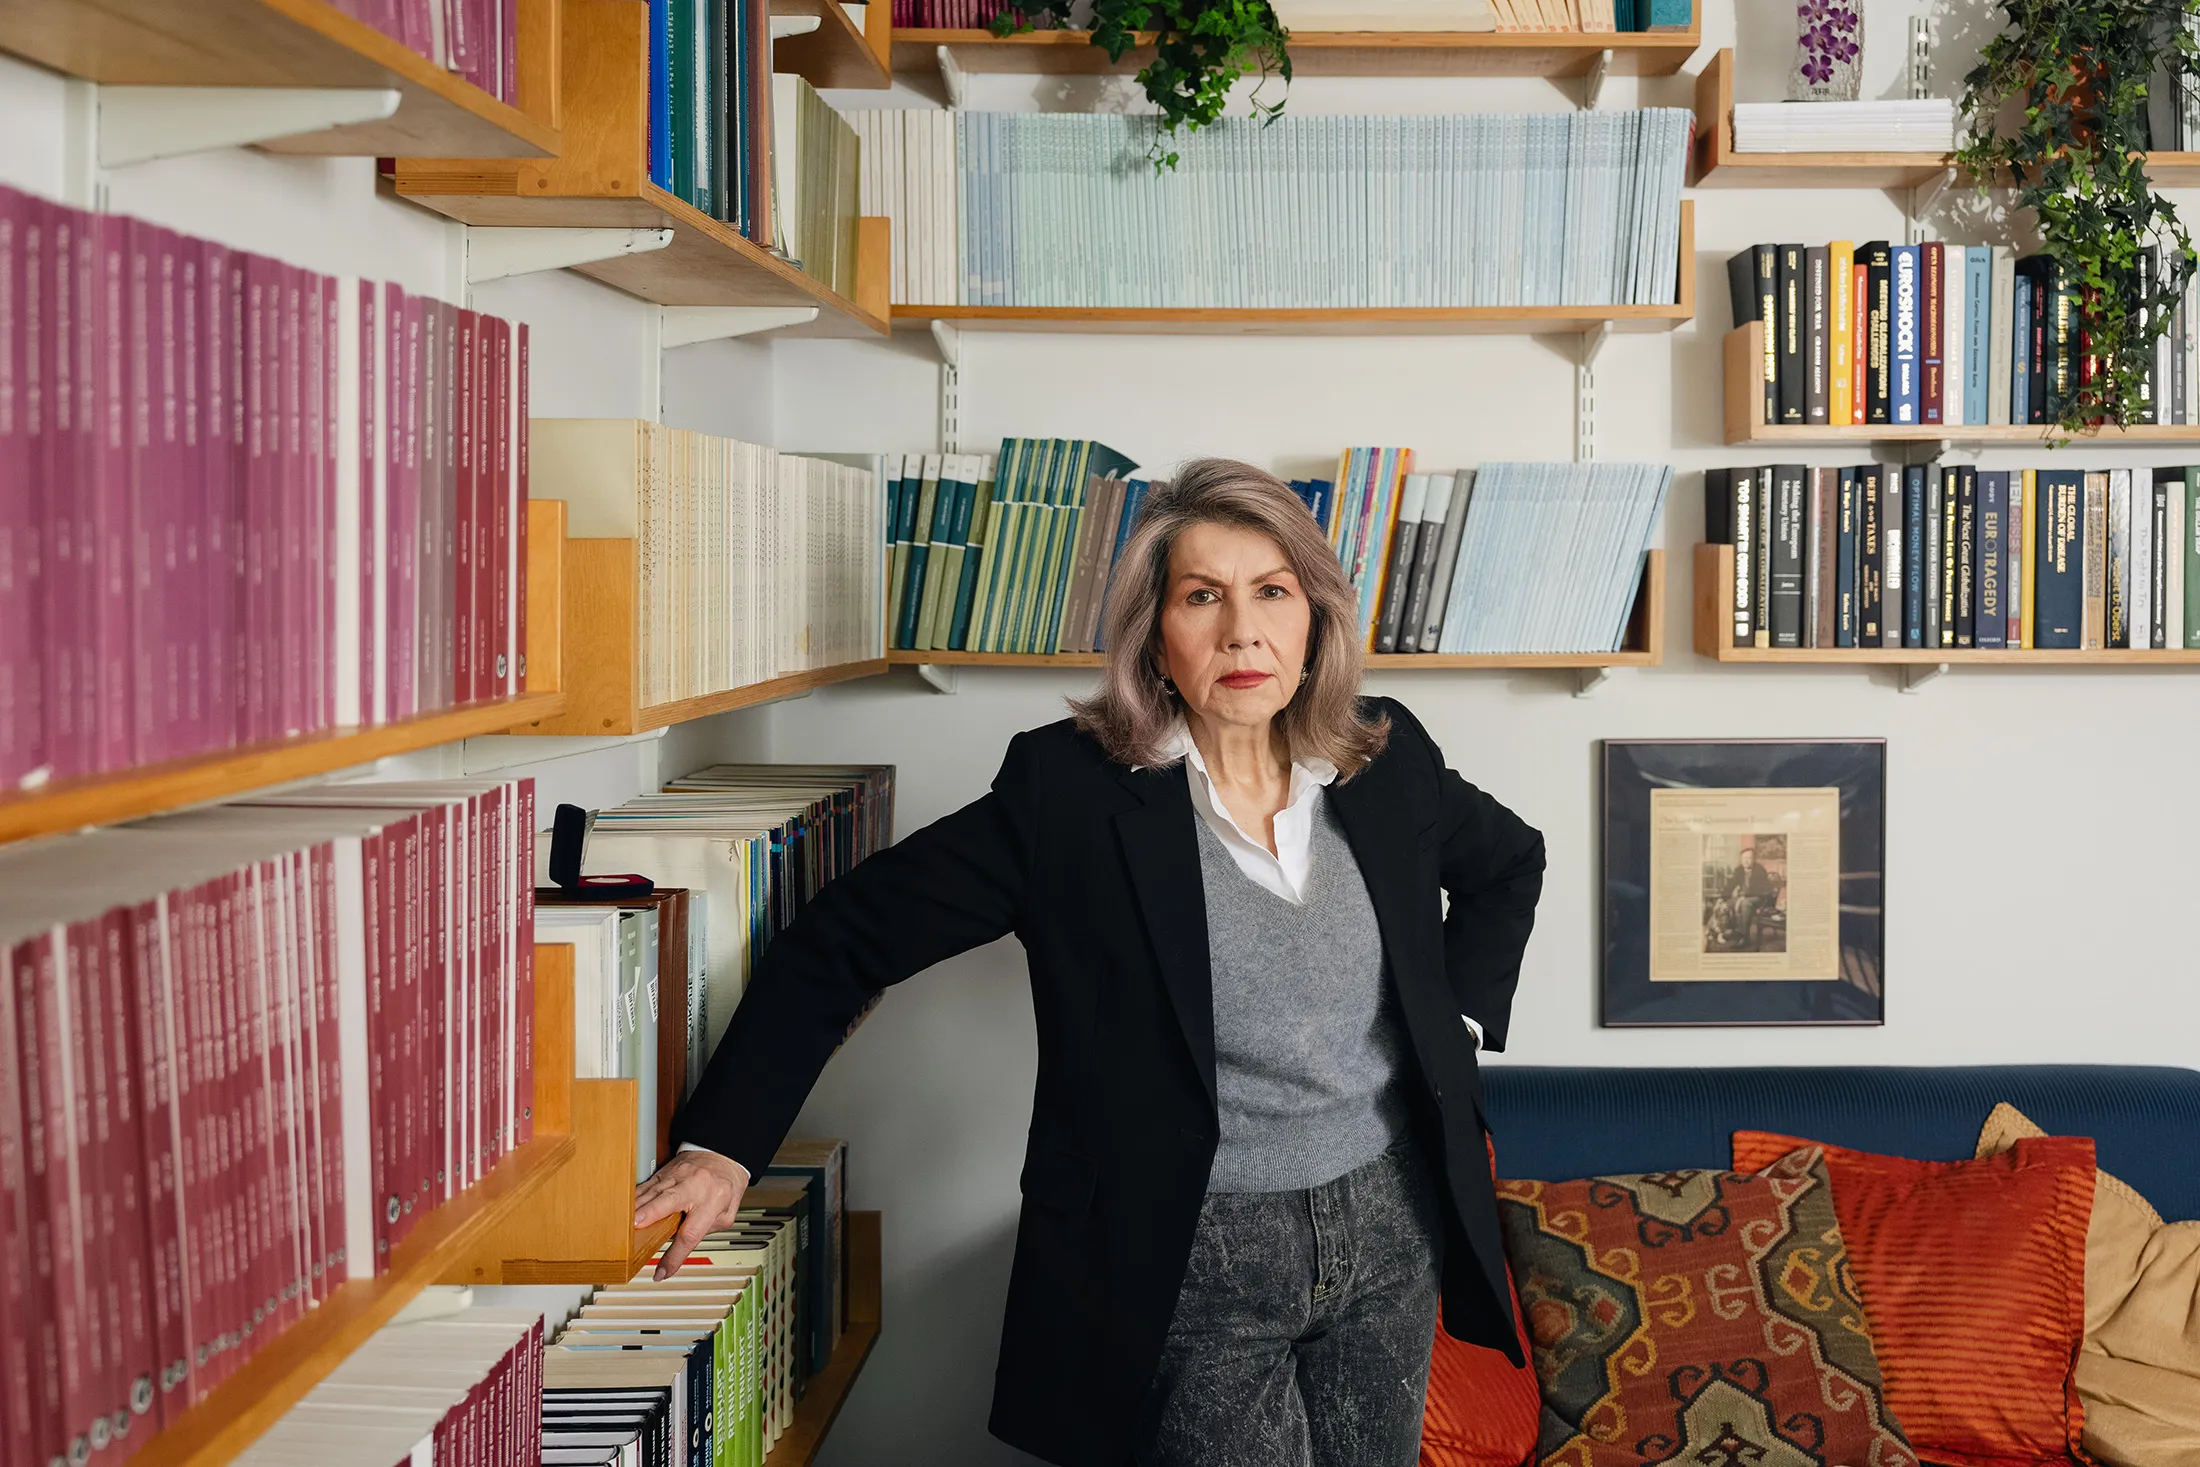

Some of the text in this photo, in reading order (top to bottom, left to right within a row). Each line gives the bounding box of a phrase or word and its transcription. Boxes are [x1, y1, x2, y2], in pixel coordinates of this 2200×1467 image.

[1780, 480, 1789, 541] Monetary Union
[1791, 480, 1800, 509] Making
[1912, 479, 1920, 522] OPTIMAL
[2009, 477, 2022, 554] TEN CRISES
[2067, 484, 2076, 542] THE GLOBAL
[1789, 524, 1799, 559] European
[1912, 526, 1920, 562] MONEY
[2057, 484, 2066, 573] BURDEN OF DISEASE
[1912, 564, 1920, 593] FLOW
